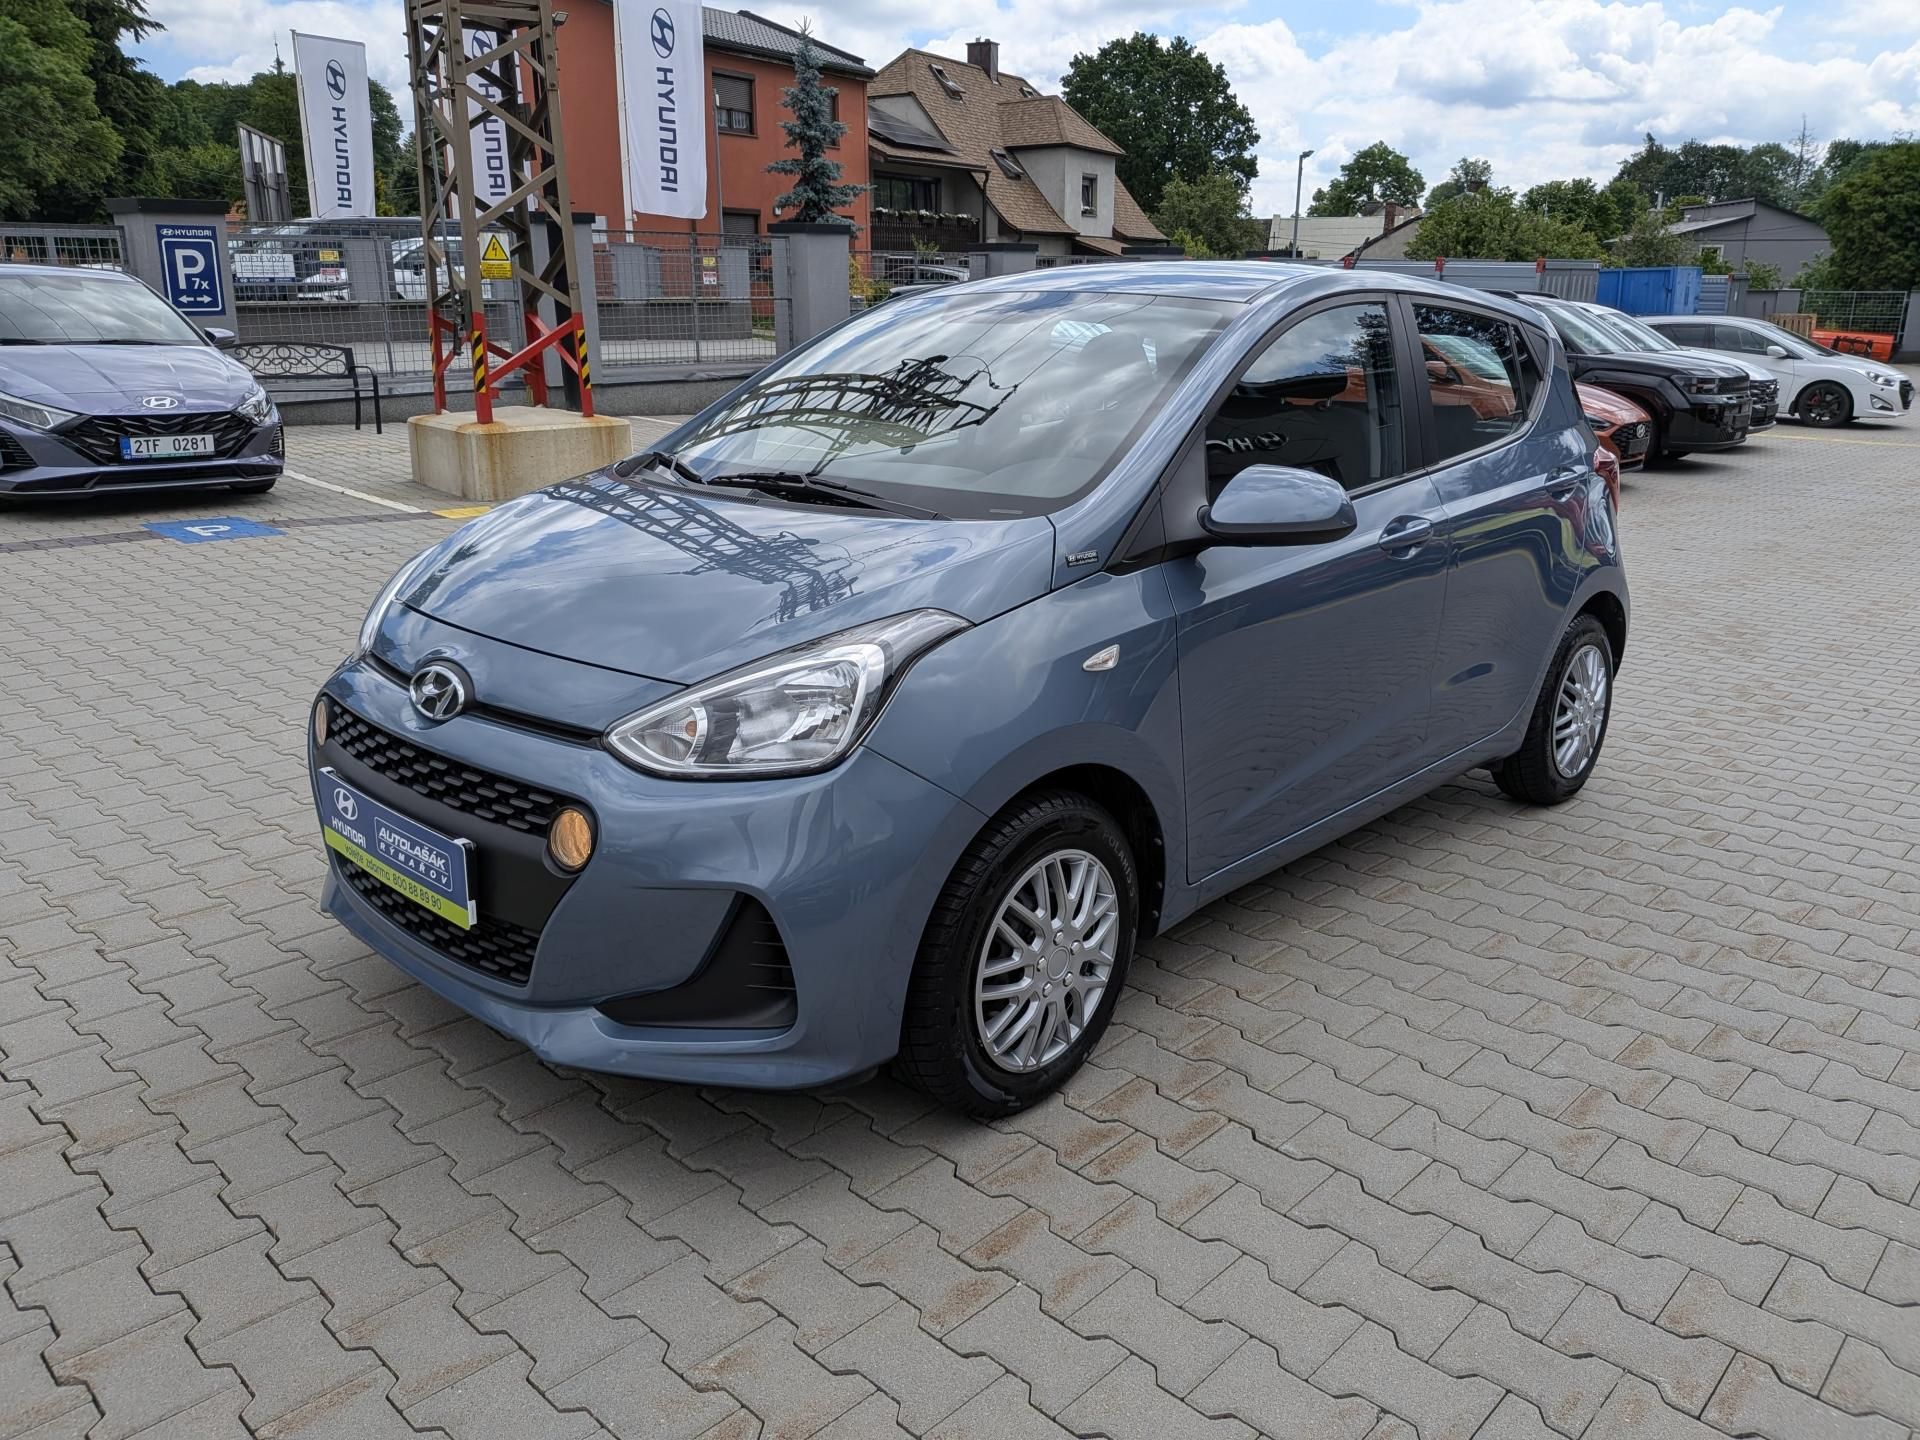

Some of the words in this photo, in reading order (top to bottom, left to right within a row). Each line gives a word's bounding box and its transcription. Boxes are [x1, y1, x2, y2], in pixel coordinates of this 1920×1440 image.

[478, 82, 507, 197] HUNDAI
[656, 66, 678, 193] HYUNDAI
[331, 106, 352, 209] HYUNDAI
[174, 228, 213, 237] HYUNDAI
[174, 248, 205, 290] P
[191, 277, 211, 290] 7x
[134, 439, 160, 454] 2TF
[172, 437, 207, 452] 0281
[331, 815, 366, 849] HYUNDAI
[378, 826, 446, 871] AUTOLAŠÁK
[344, 843, 364, 865] volejte
[366, 857, 391, 881] zdarma
[392, 873, 407, 891] 800
[408, 882, 419, 898] 88
[431, 894, 442, 910] 90
[379, 841, 448, 885] RÝMAŘOV
